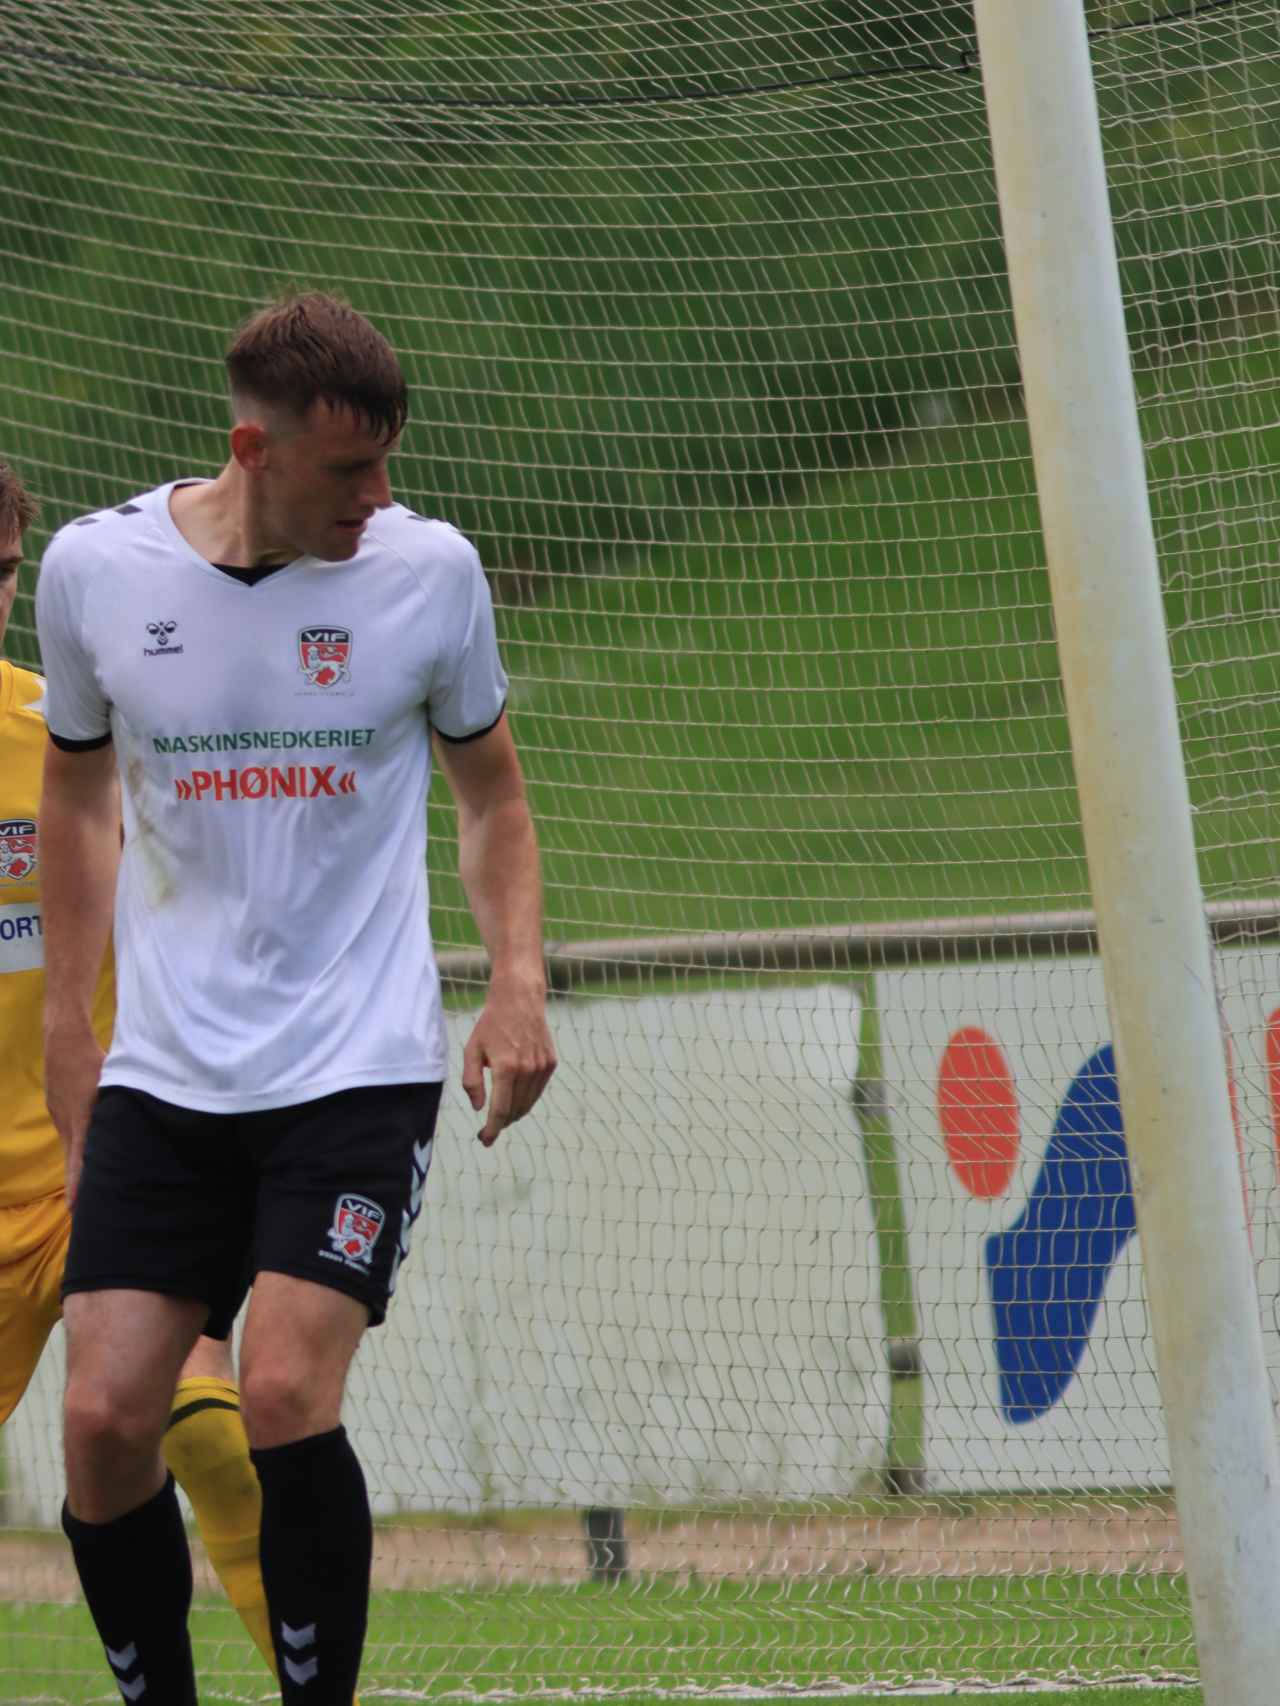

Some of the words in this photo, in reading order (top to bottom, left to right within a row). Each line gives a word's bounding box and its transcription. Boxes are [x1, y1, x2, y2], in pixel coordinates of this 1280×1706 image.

[304, 632, 349, 643] VIF
[143, 644, 184, 657] hummel
[152, 728, 376, 754] MASKINSNEDKERIET
